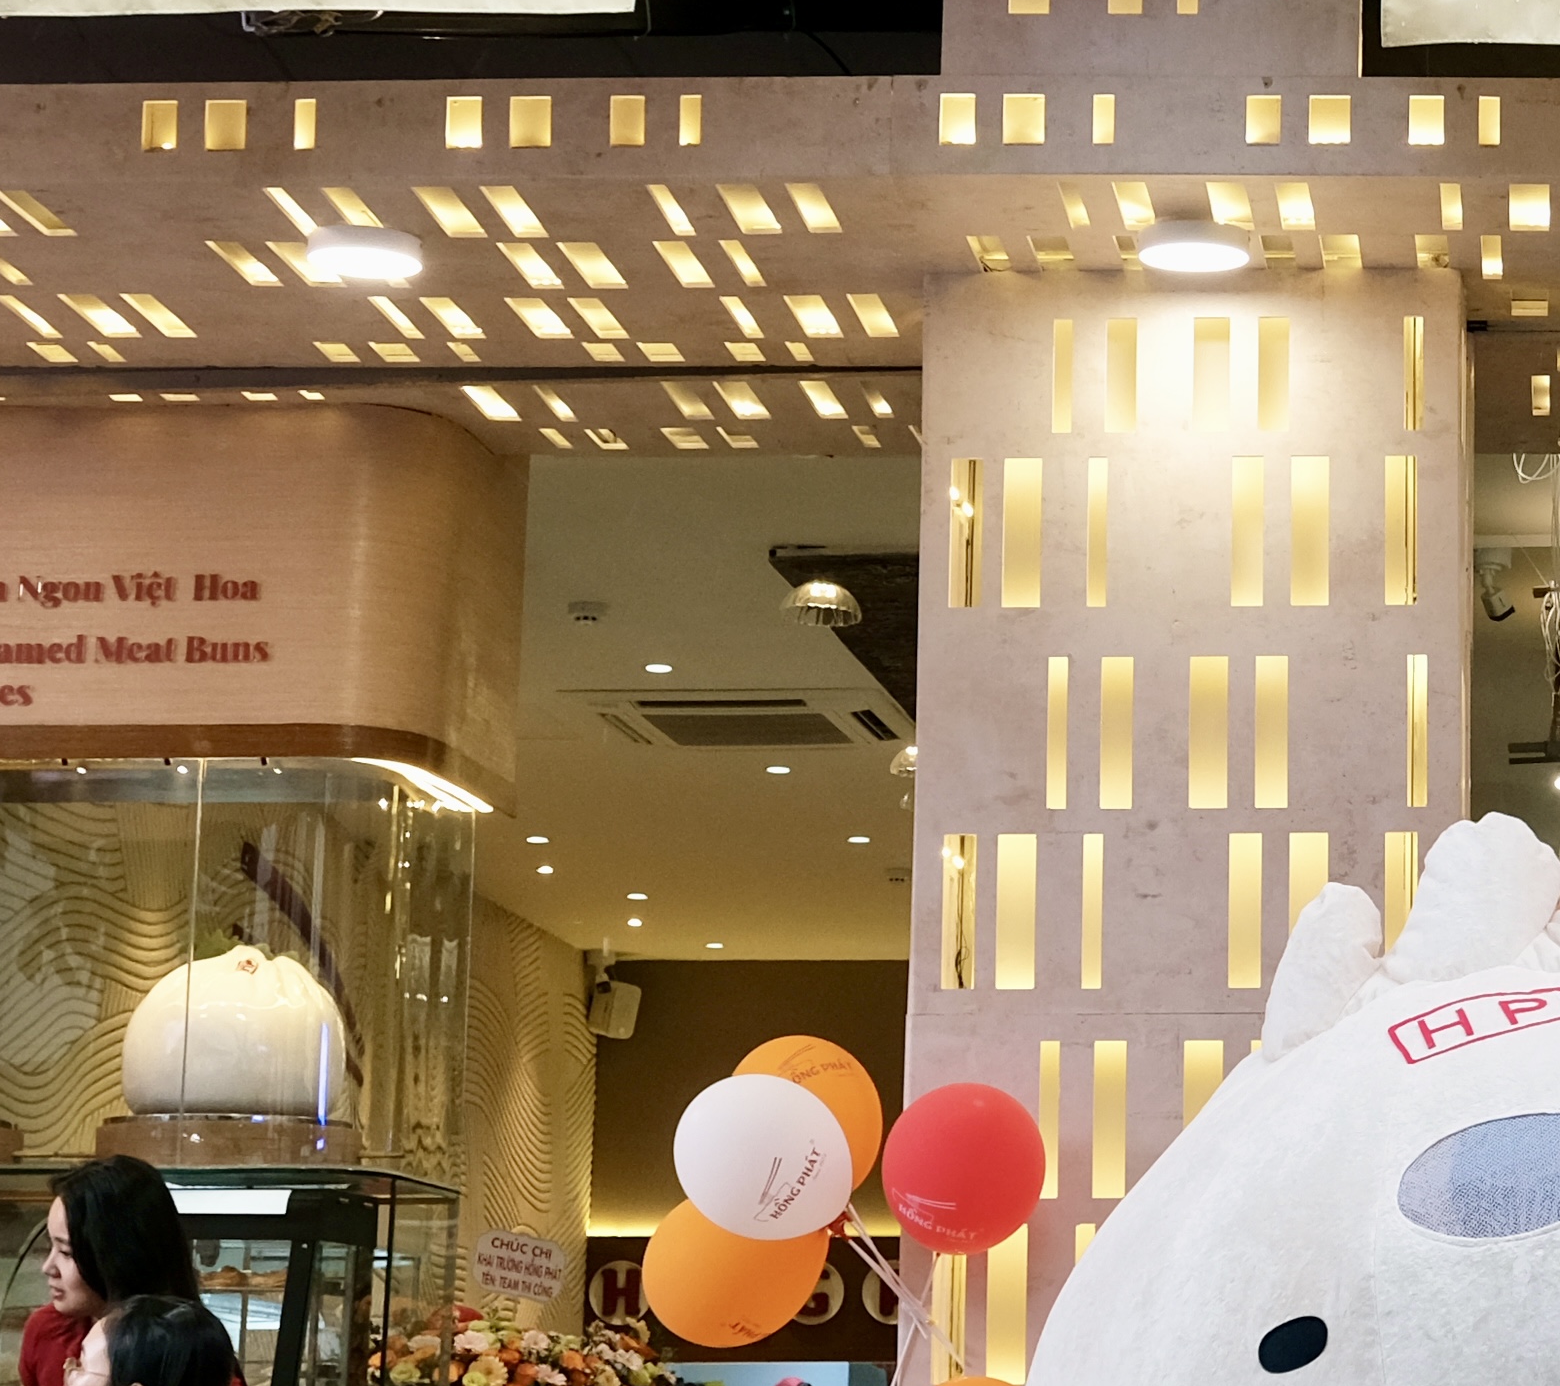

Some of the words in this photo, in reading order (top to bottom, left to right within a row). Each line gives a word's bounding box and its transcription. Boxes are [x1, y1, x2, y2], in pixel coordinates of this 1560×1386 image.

[18, 574, 105, 609] Ngon
[111, 569, 178, 608] Việt
[192, 572, 262, 602] Hoa
[94, 635, 179, 665] Meat
[184, 635, 271, 665] Buns
[1417, 997, 1548, 1050] HP
[769, 1184, 801, 1220] HỒNG
[795, 1146, 822, 1187] PHÁT
[898, 1202, 933, 1231] HỒNG
[491, 1237, 529, 1255] CHÚC
